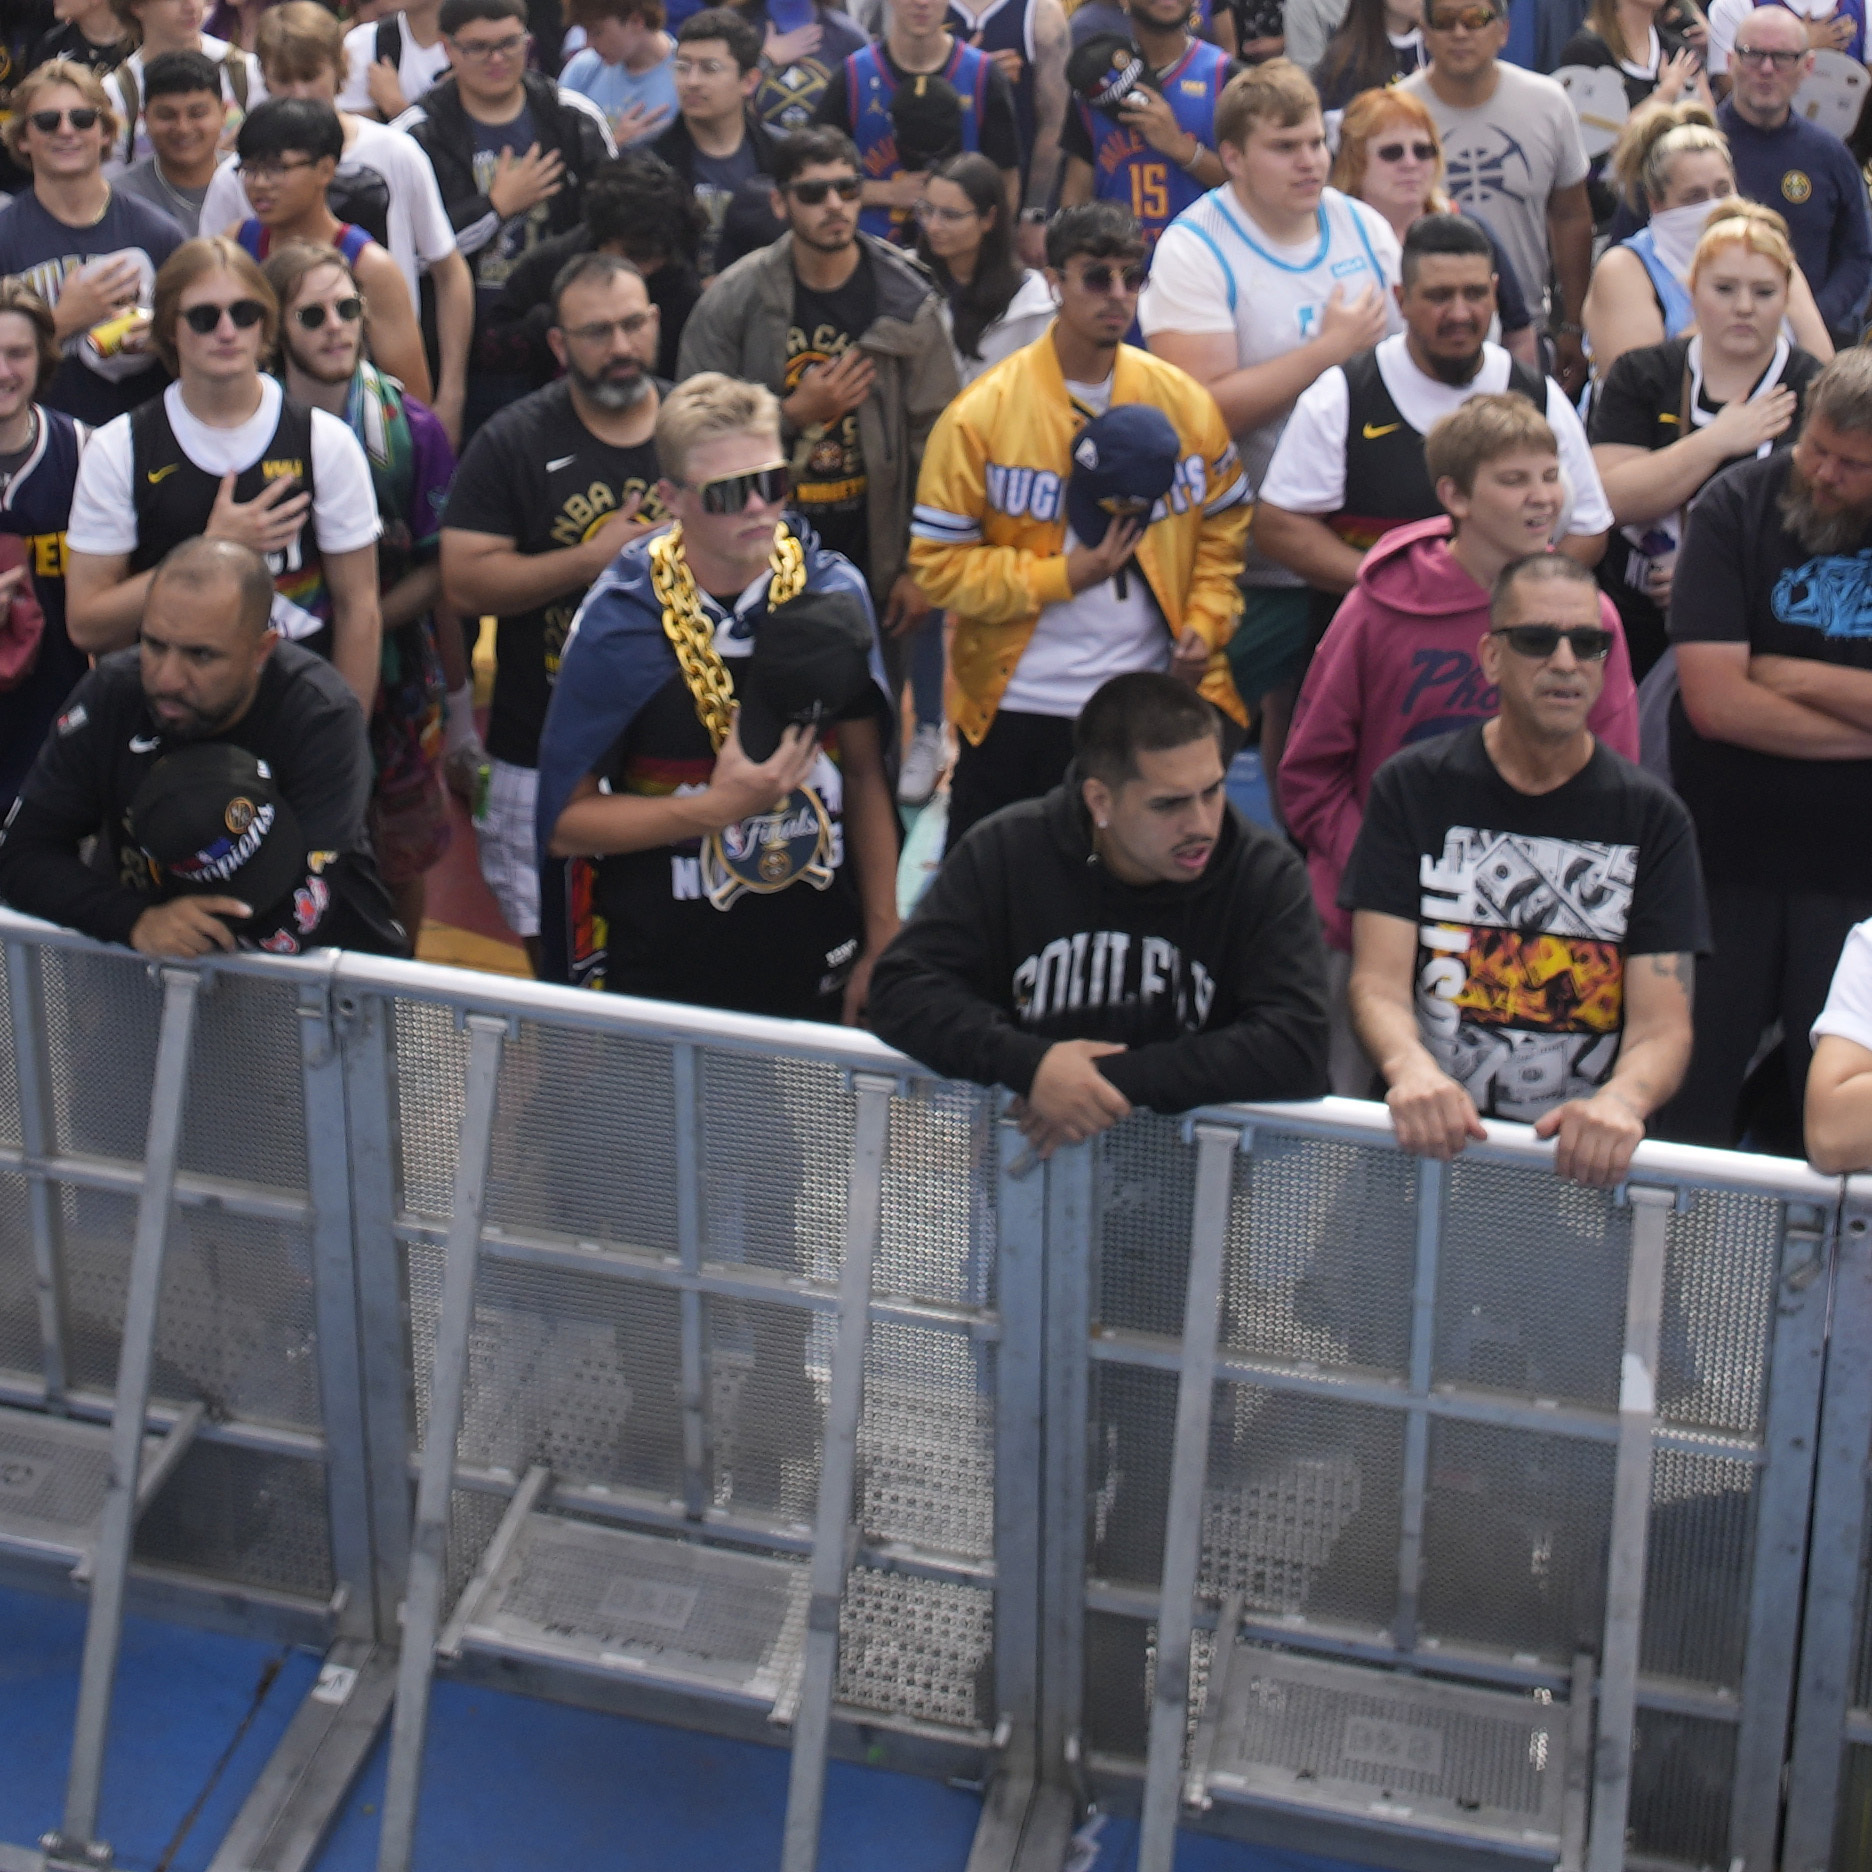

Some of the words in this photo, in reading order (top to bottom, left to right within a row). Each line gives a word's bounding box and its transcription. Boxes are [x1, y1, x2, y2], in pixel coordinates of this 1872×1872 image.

[1129, 164, 1167, 219] 15
[552, 480, 616, 545] NBA
[736, 814, 820, 861] Finals
